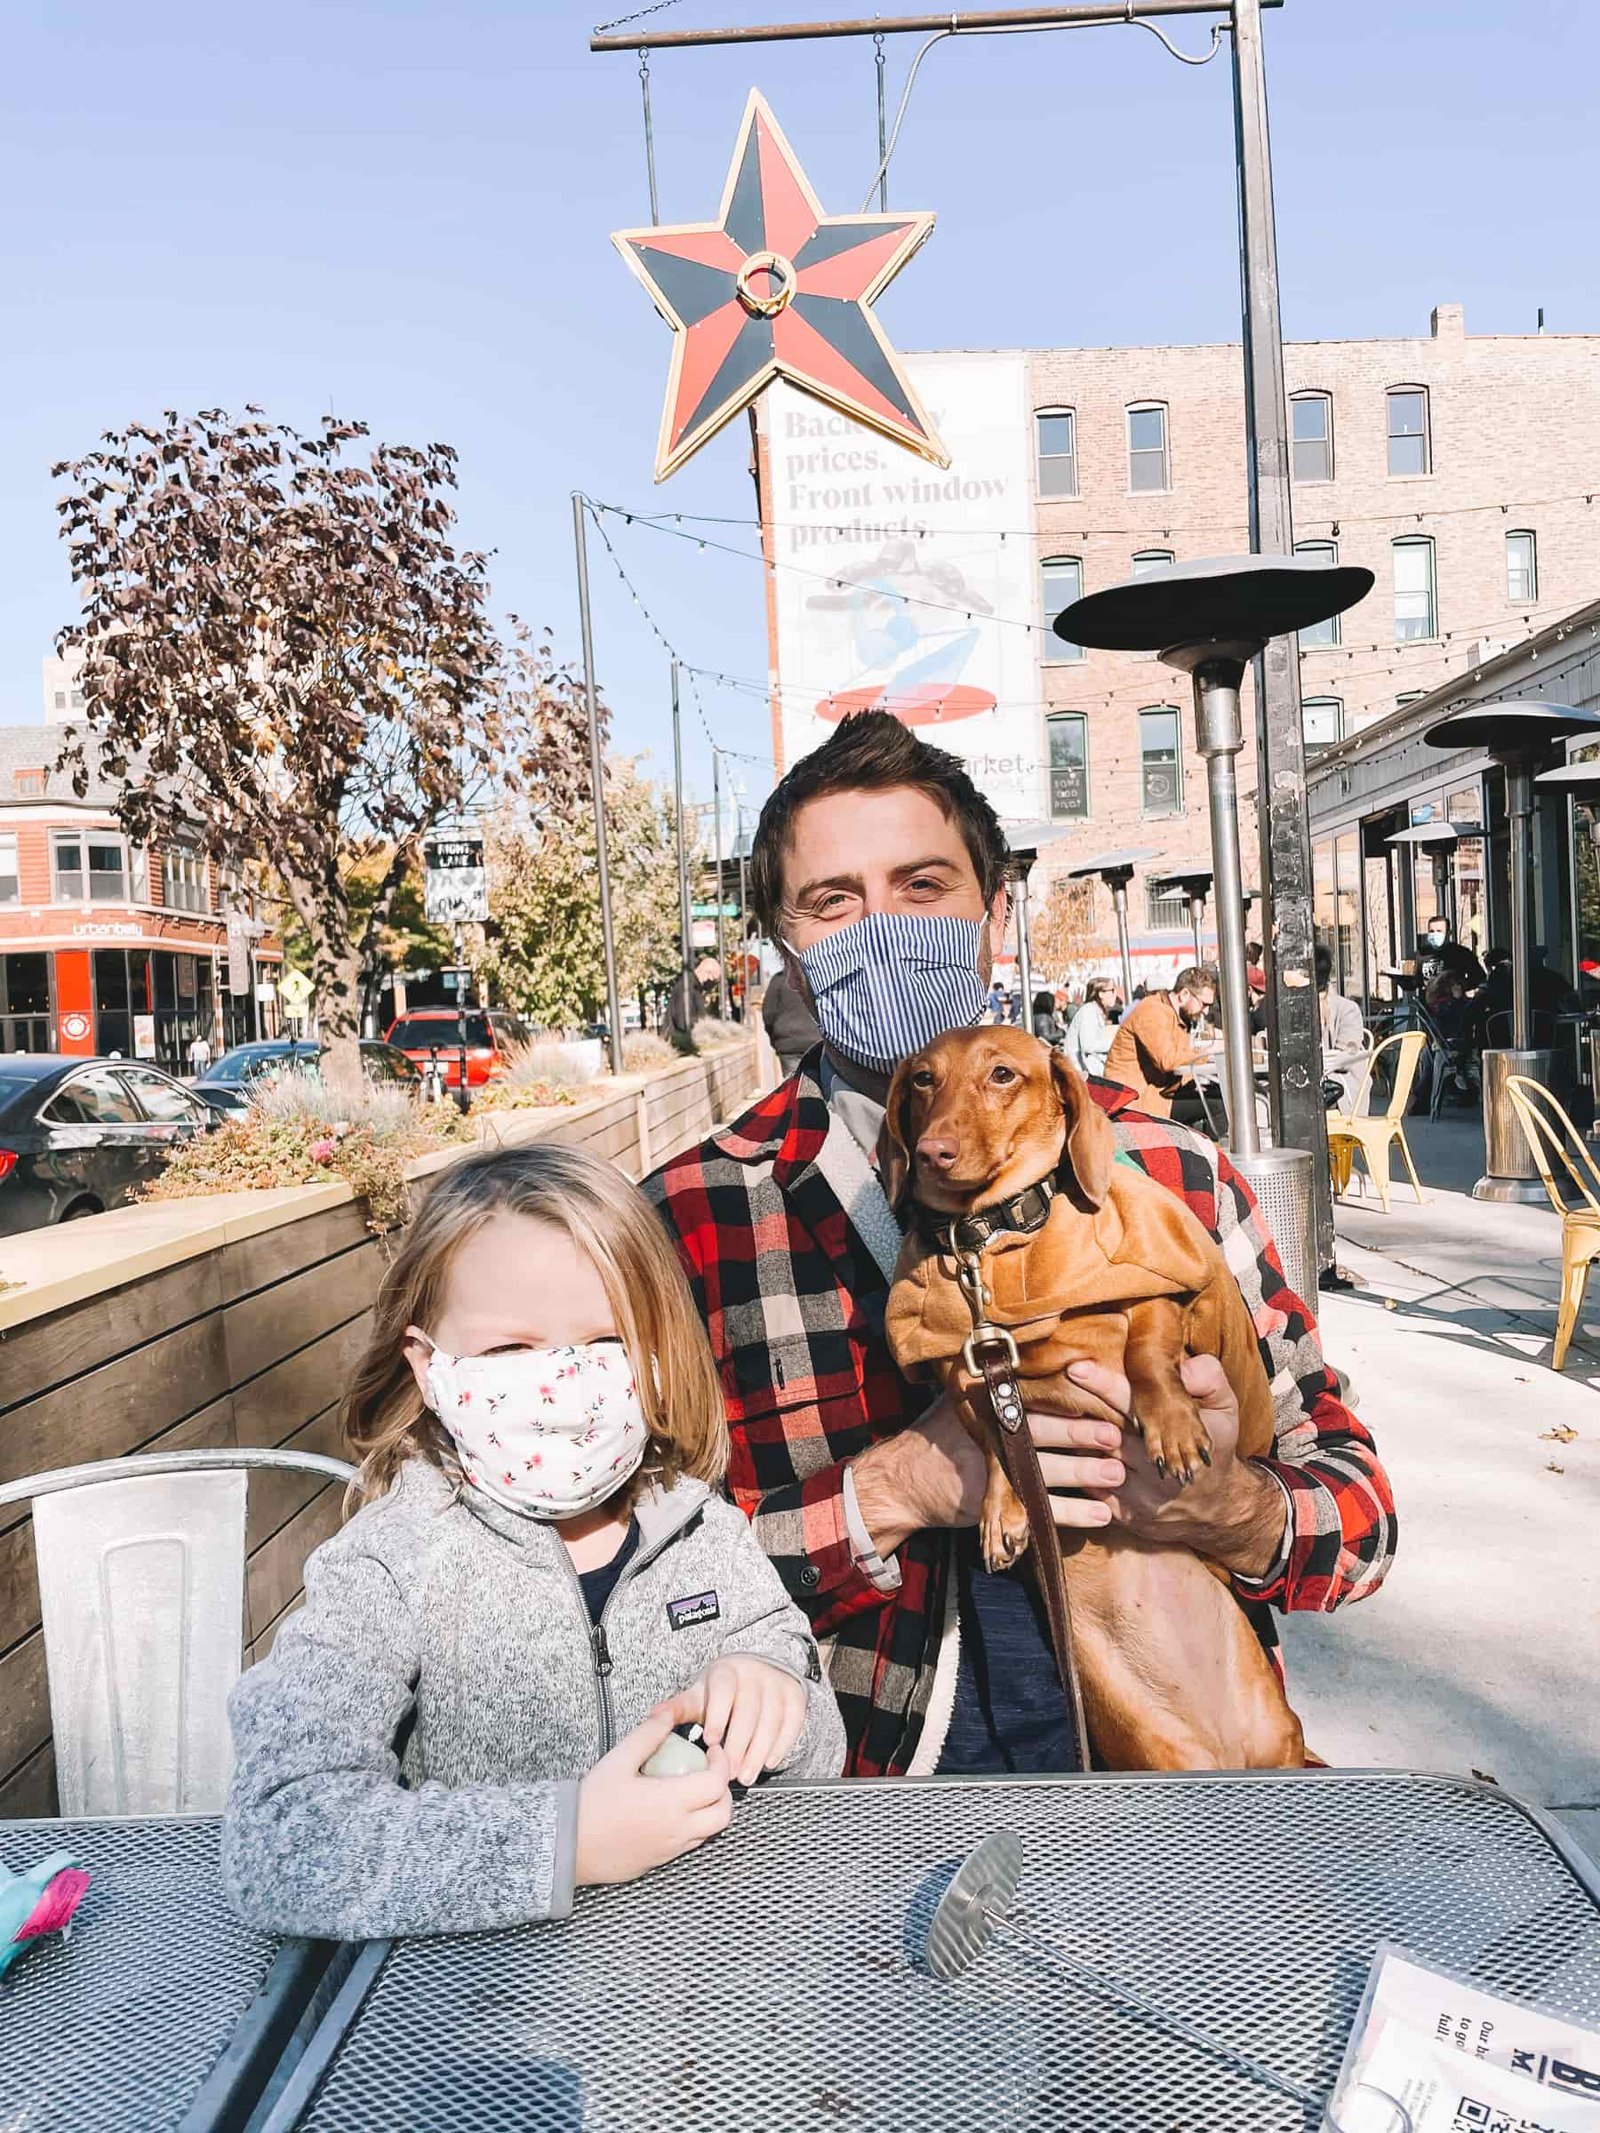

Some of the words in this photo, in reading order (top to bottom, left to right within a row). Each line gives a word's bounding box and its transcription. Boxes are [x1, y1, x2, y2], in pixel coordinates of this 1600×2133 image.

[786, 443, 888, 481] prices.
[789, 483, 873, 510] Front
[882, 475, 1009, 504] window
[790, 514, 936, 554] products.
[437, 843, 469, 855] RIGHT
[439, 854, 470, 867] LANE
[1437, 2013, 1453, 2036] full
[1460, 2017, 1472, 2033] to
[1480, 2021, 1495, 2044] Our
